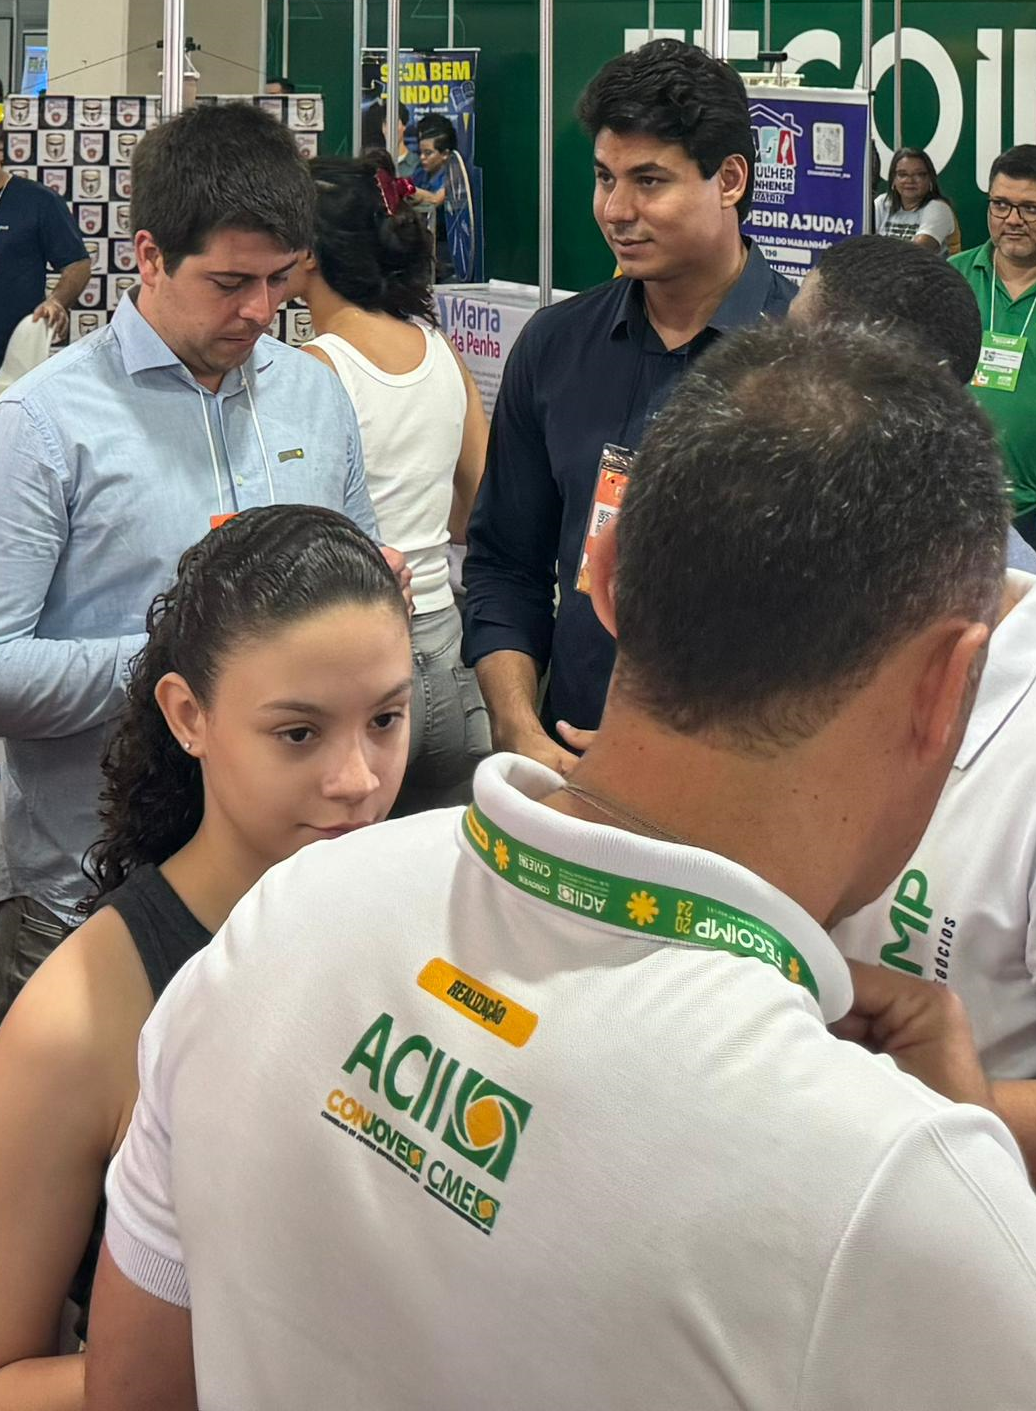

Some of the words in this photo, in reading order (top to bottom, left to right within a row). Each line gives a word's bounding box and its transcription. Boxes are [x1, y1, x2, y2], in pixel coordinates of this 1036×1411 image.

[380, 62, 428, 82] SJA
[430, 60, 471, 81] BEM
[755, 180, 793, 192] NHENSE
[756, 165, 793, 180] ULHER
[790, 213, 854, 236] AJUDA?
[450, 296, 501, 333] Maria
[466, 330, 500, 359] Penha
[675, 916, 692, 935] 20
[694, 917, 783, 970] FECOIMP
[934, 916, 956, 986] GÓCIOS
[446, 979, 507, 1025] REALIZAÇÃO
[341, 1012, 460, 1133] ACII
